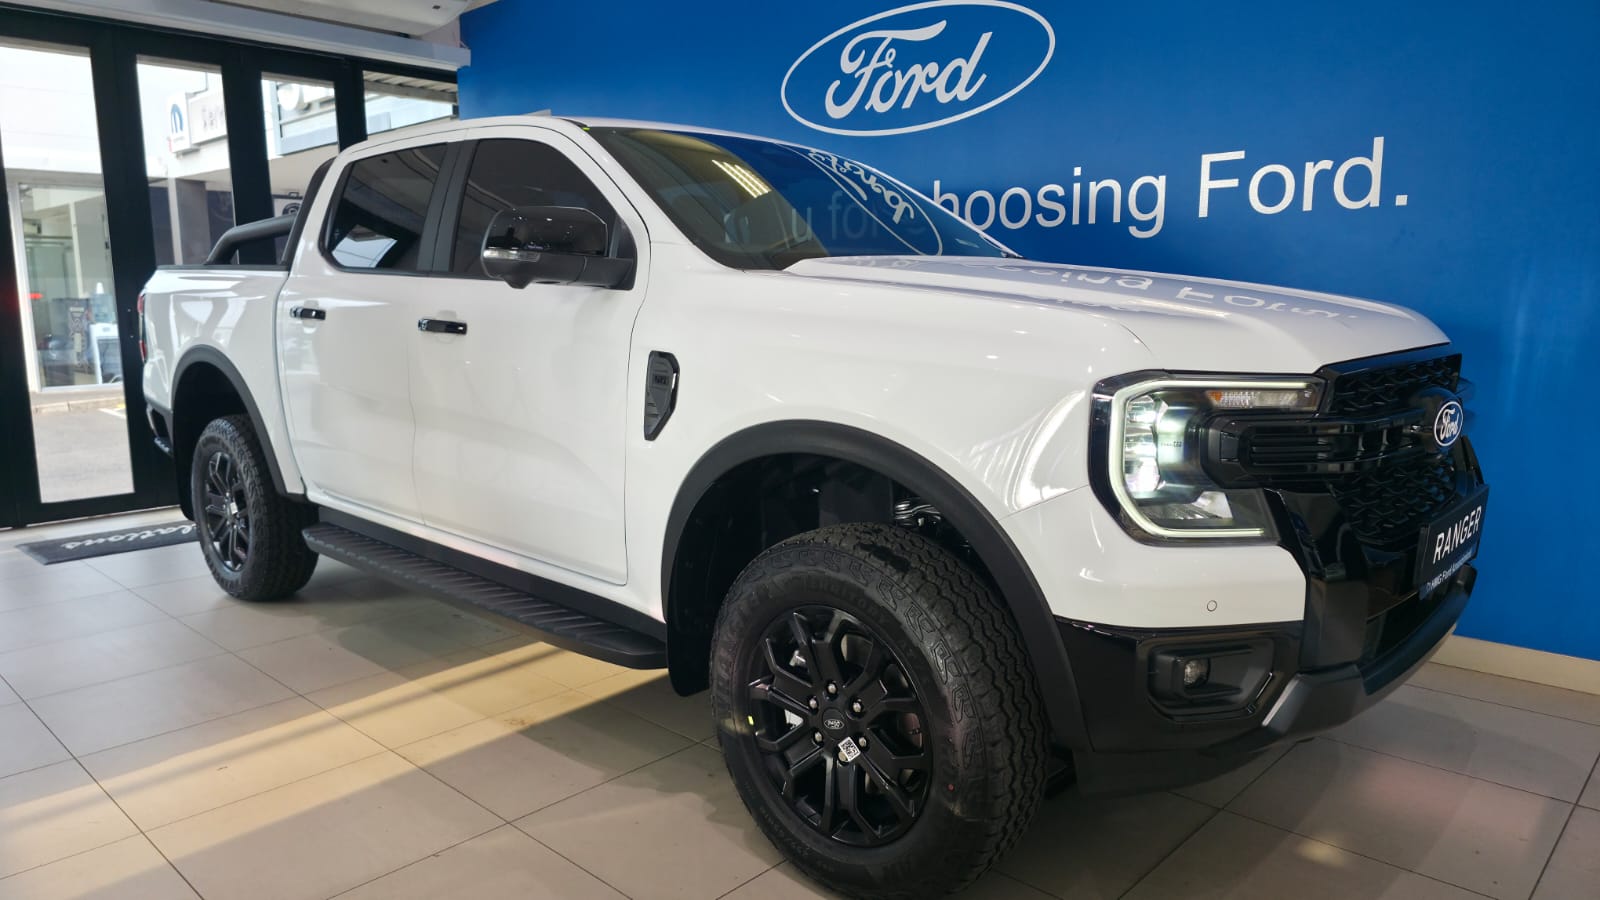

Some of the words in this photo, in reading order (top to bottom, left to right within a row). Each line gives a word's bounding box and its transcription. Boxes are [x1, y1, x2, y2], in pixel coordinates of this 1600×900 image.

[825, 20, 993, 119] Ford
[930, 166, 1167, 240] hoosing
[1198, 136, 1408, 218] Ford.
[61, 523, 196, 550] lations
[1432, 505, 1482, 565] RANGER
